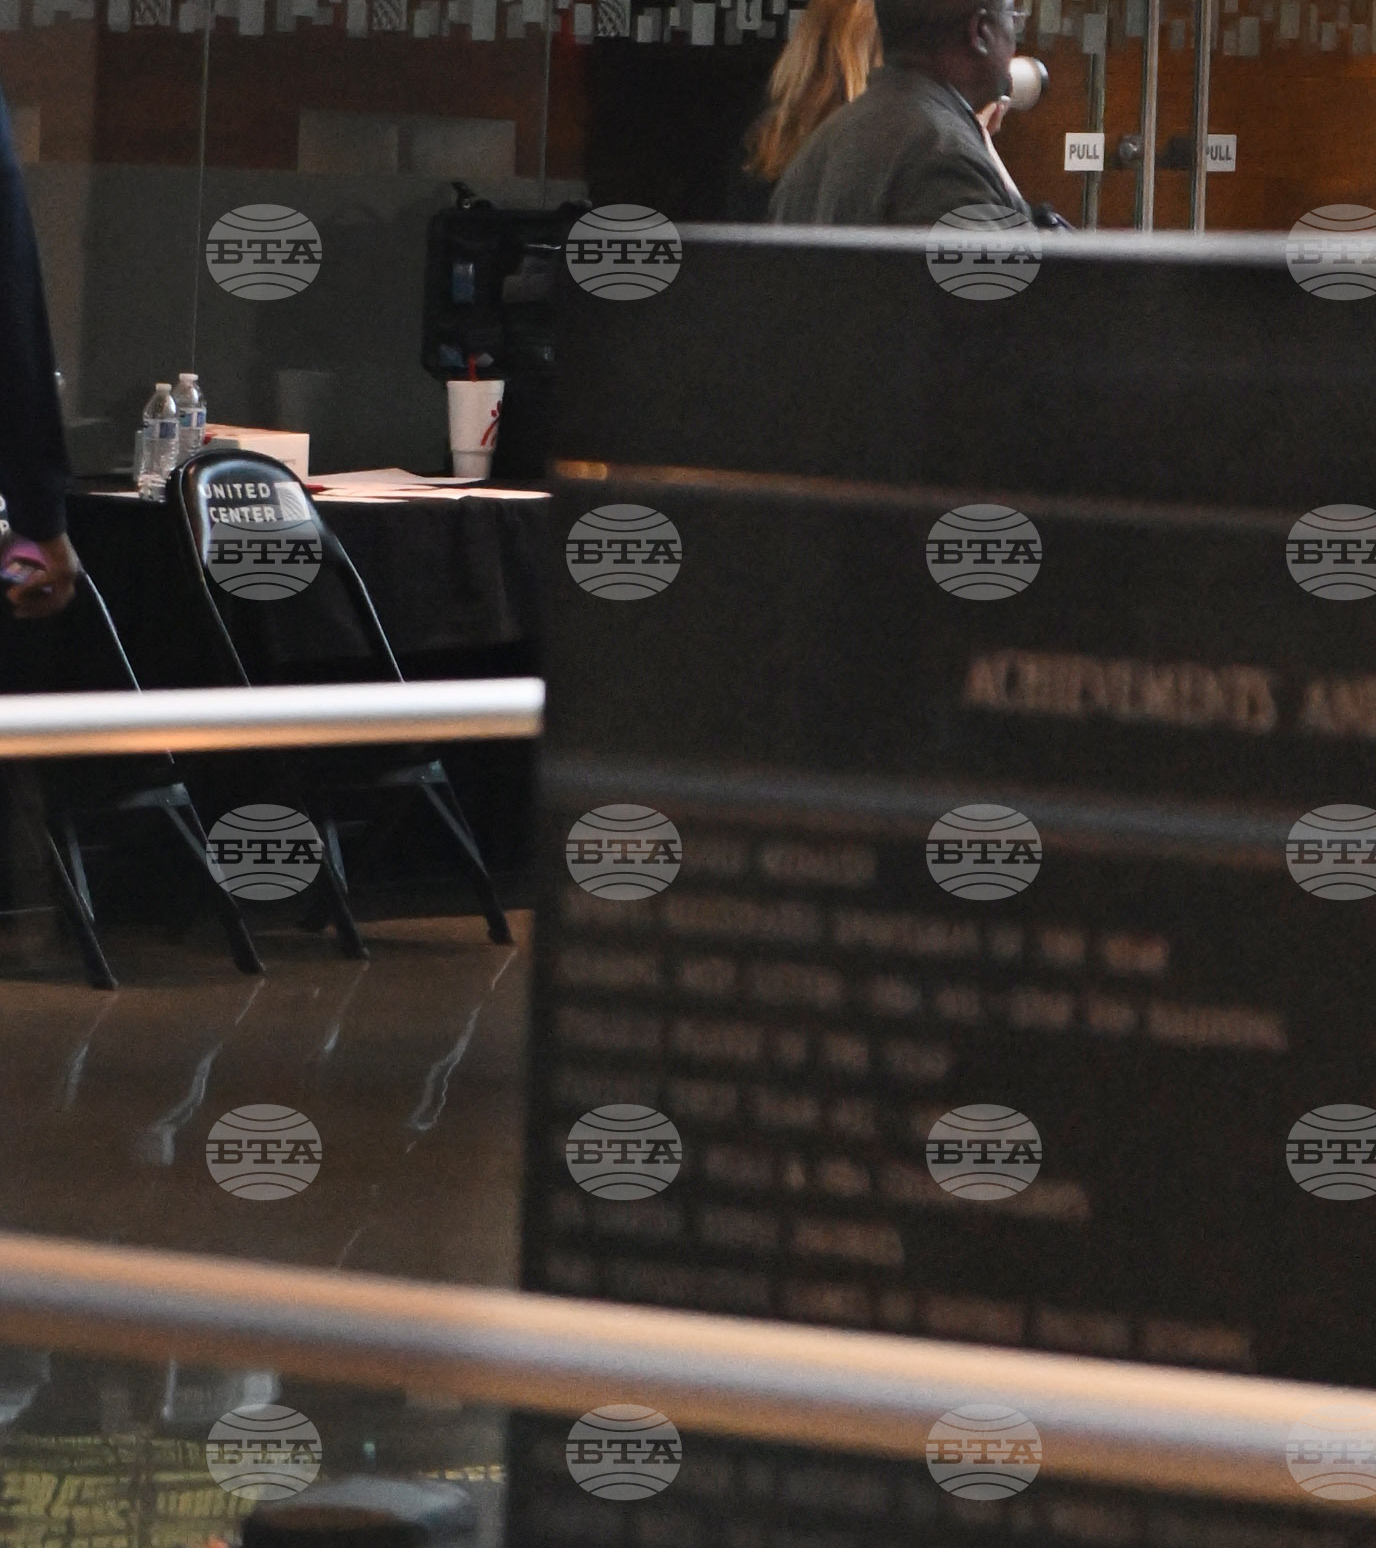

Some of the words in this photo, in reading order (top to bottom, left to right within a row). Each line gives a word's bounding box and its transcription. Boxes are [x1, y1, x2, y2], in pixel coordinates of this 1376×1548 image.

[1069, 144, 1099, 159] PULL
[204, 482, 271, 499] UNITED
[210, 506, 277, 523] CENTER
